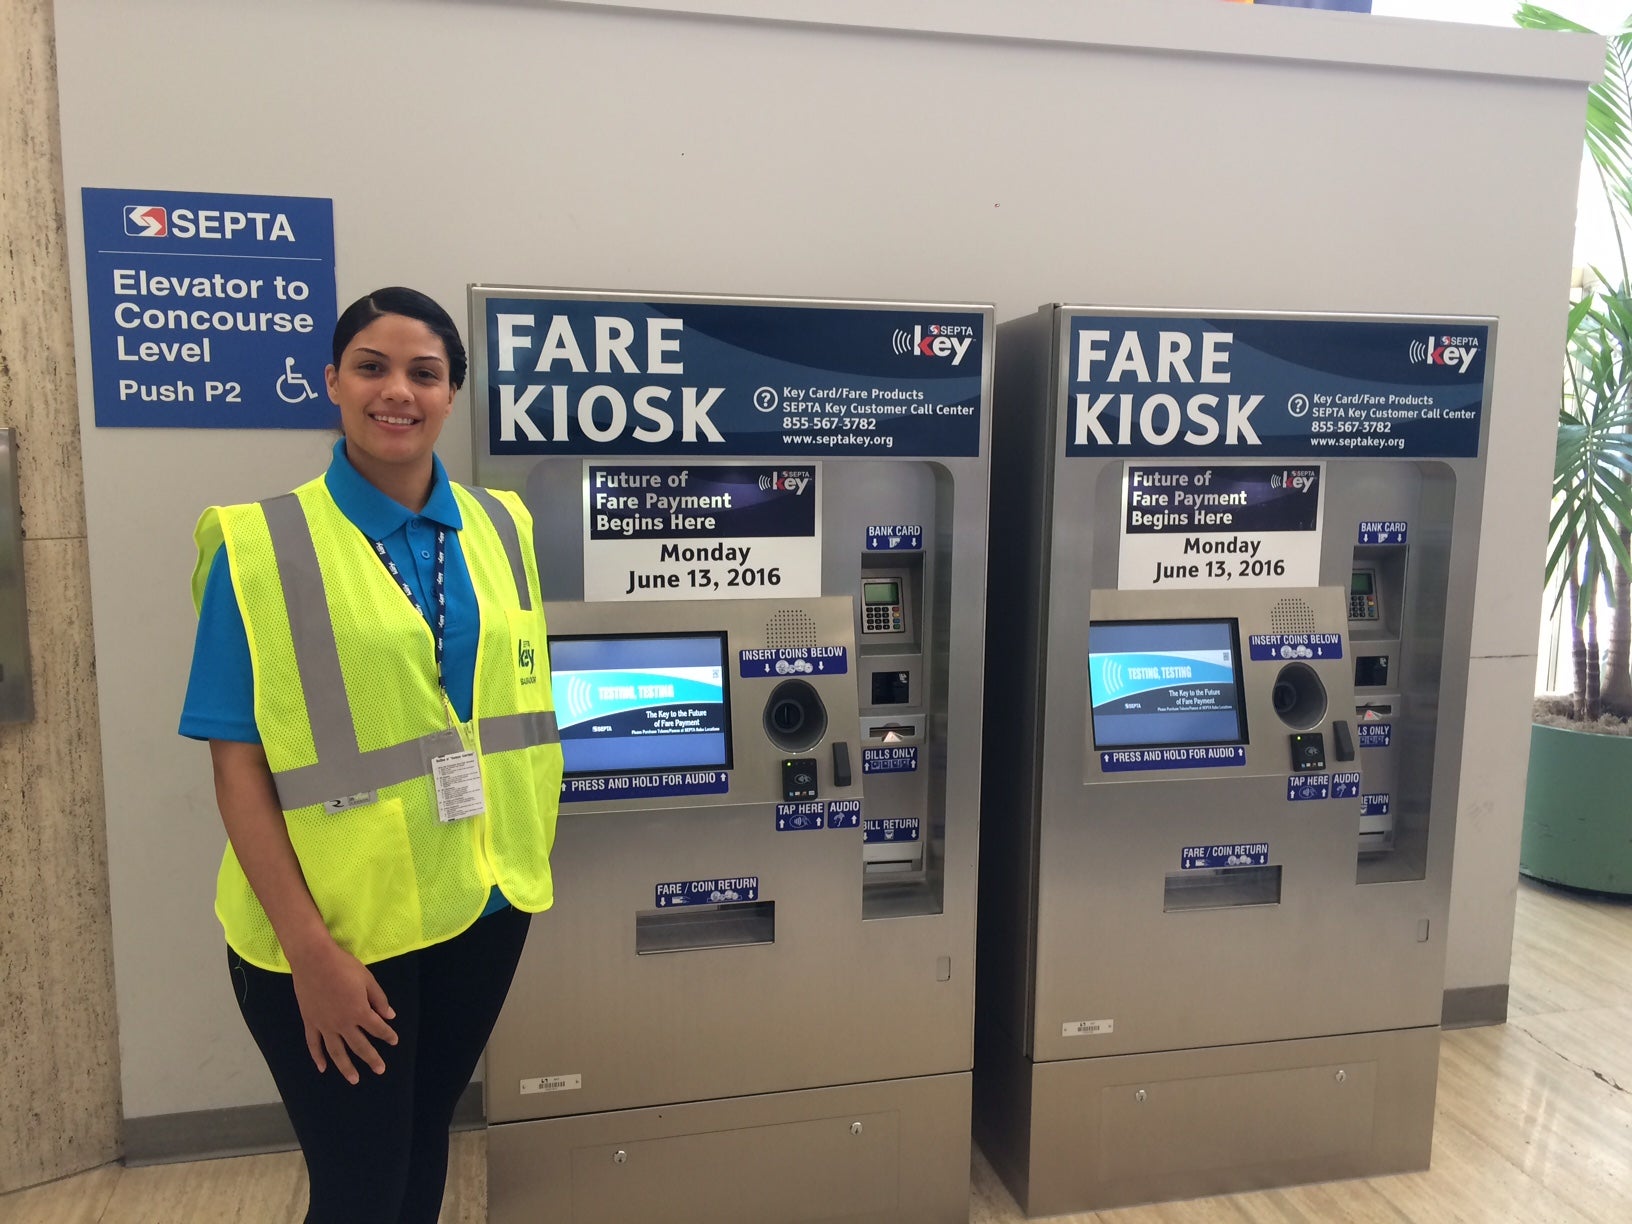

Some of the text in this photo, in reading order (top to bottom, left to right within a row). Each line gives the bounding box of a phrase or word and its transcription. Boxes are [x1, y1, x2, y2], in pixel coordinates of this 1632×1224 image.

[171, 208, 296, 242] SEPTA
[113, 269, 309, 300] Elevator to
[114, 302, 314, 333] Concourse
[940, 325, 973, 336] SEPTA
[496, 313, 685, 374] FARE
[914, 325, 973, 366] key
[1450, 336, 1479, 346] SEPTA
[117, 335, 211, 363] Level
[1076, 329, 1234, 383] FARE
[1426, 336, 1478, 374] key
[119, 379, 242, 403] Push P2
[783, 386, 924, 400] Key Card/Fare Products
[1313, 393, 1434, 406] Key Card/Fare Products
[498, 384, 726, 443] KIOSK
[782, 401, 975, 417] SEPTA Key Customer Call Center
[1312, 407, 1476, 420] SEPTA Key Customer Call Center
[782, 417, 876, 430] 855-567-3782
[1073, 393, 1265, 446] KIOSK
[1311, 421, 1391, 433] 855-567-3782
[782, 433, 893, 447] www.septakey.org
[1310, 436, 1405, 449] www.septakey.org
[595, 470, 689, 488] Future of
[772, 471, 809, 495] key
[1133, 470, 1212, 487] Future of
[1282, 470, 1314, 493] key
[596, 492, 732, 514] Fare Payment
[1132, 490, 1247, 510] Fare Payment
[596, 514, 716, 535] Begins Here
[1132, 510, 1233, 530] Begins Here
[1360, 522, 1406, 532] BANK CARD
[868, 525, 921, 537] BANK CARD
[660, 542, 751, 567] Monday
[1183, 536, 1261, 558] Monday
[1153, 559, 1285, 583] June 13, 2016
[626, 567, 781, 594] June 13, 2016
[1252, 634, 1339, 645] INSERT COINS BELOW
[742, 646, 843, 661] INSERT COINS BELOW
[1128, 665, 1192, 680] TESTING, TESTING
[638, 684, 675, 699] TESTING
[1169, 689, 1178, 697] The
[1179, 689, 1188, 697] Key
[1194, 697, 1215, 705] Payment
[658, 710, 669, 719] Key
[671, 710, 677, 718] to
[678, 709, 687, 717] the
[688, 709, 707, 717] Future
[654, 719, 700, 728] of Fare Payment
[1369, 726, 1389, 735] ONLY
[864, 747, 916, 760] BILLS ONLY
[1113, 747, 1235, 763] PRESS AND HOLD FOR AUDIO
[571, 772, 716, 792] PRESS AND HOLD FOR AUDIO
[1290, 775, 1329, 786] TAP HERE
[1333, 774, 1359, 784] AUDIO
[778, 802, 824, 815] TAP HERE
[829, 800, 860, 812] AUDIO
[883, 818, 918, 830] RETURN
[1183, 847, 1205, 858] FARE
[1212, 845, 1232, 857] COIN
[1234, 844, 1268, 855] RETURN
[657, 883, 683, 895] FARE
[691, 880, 715, 893] COIN
[718, 877, 757, 891] RETURN
